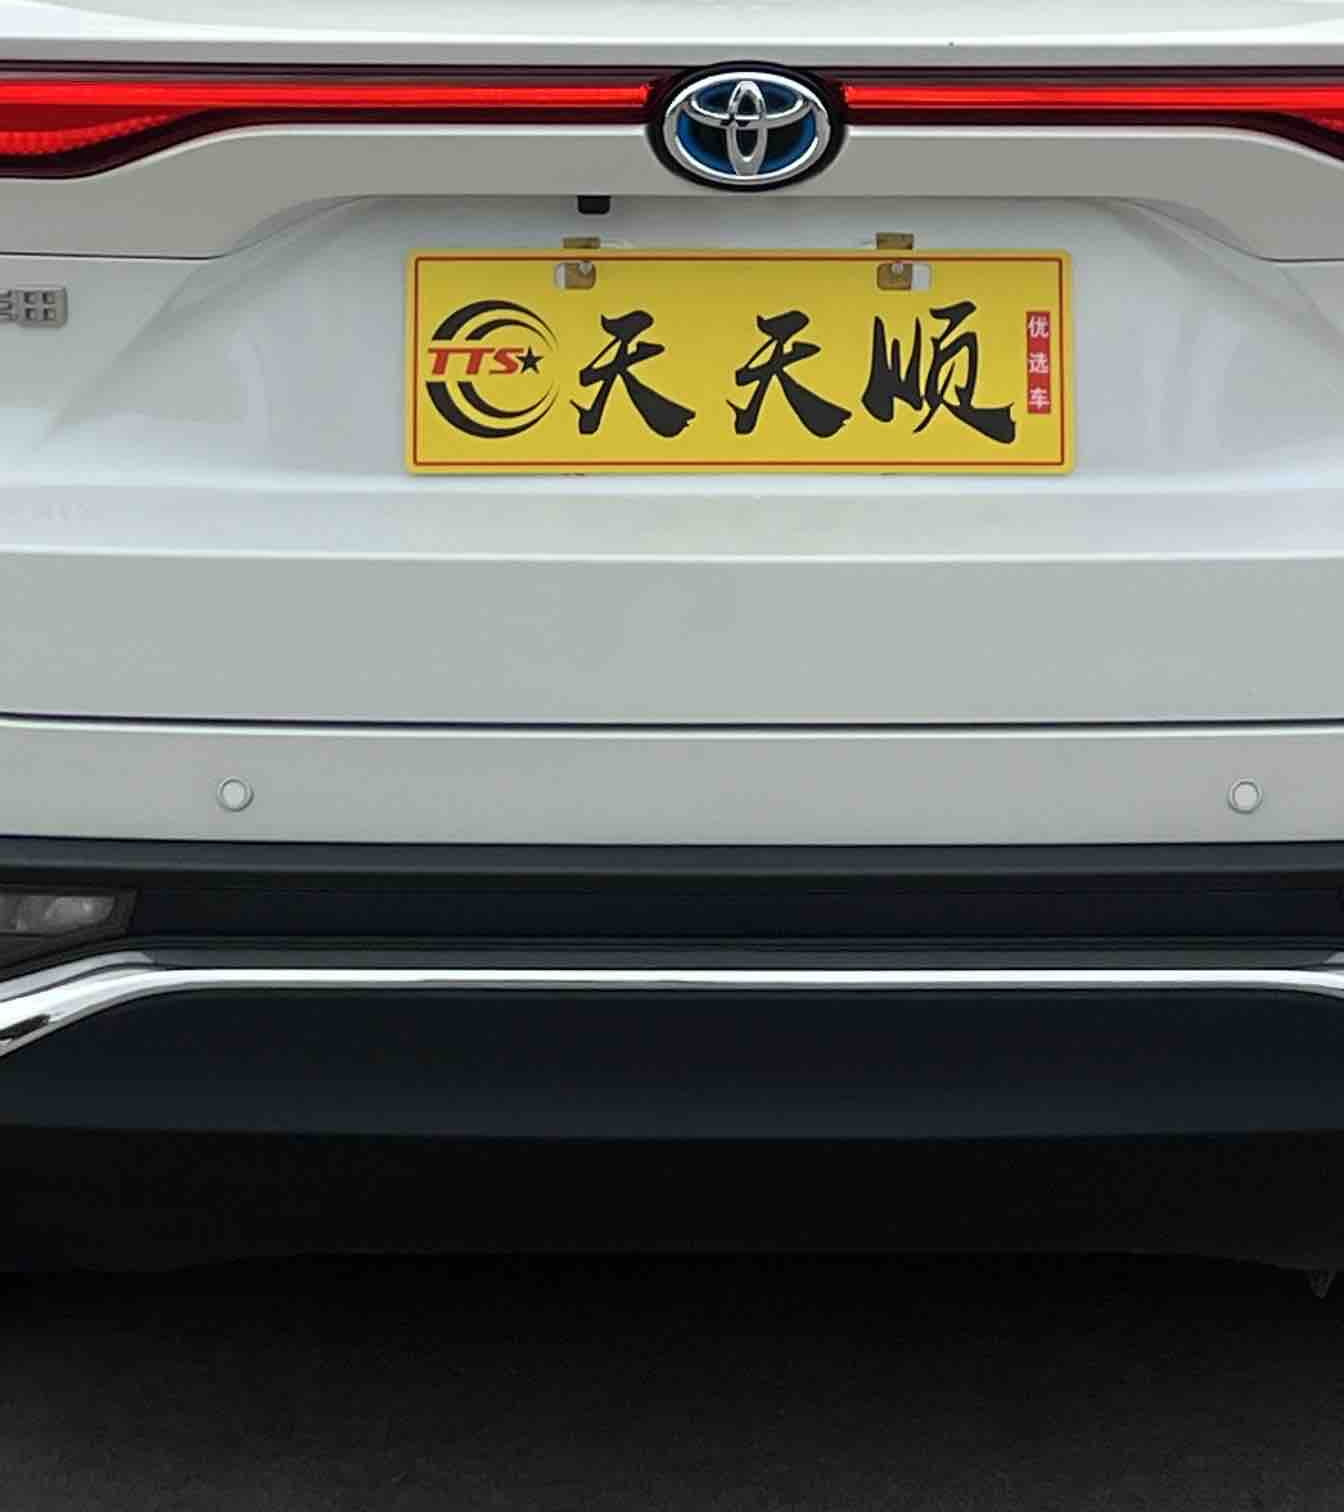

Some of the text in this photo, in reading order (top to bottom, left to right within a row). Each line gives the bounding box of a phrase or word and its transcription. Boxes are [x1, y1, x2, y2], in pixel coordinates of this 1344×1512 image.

[427, 347, 525, 376] TTS
[568, 300, 1018, 445] 天天顺
[1026, 314, 1052, 412] 优选车
